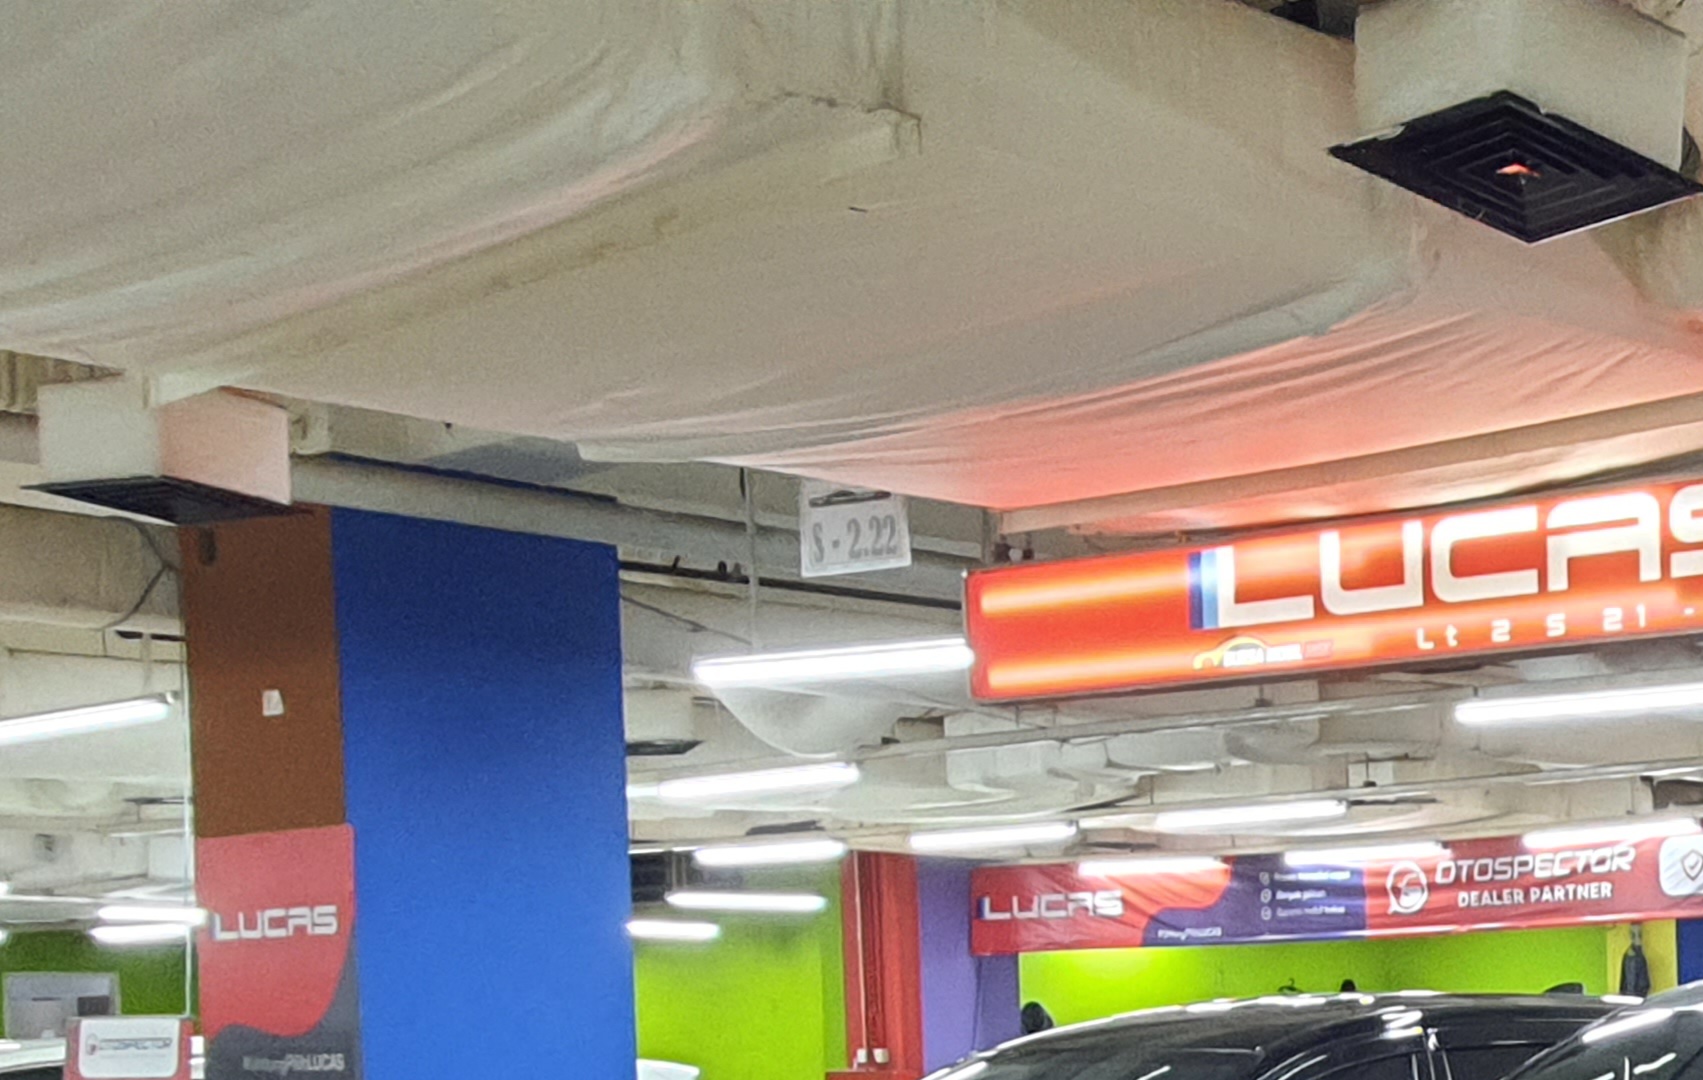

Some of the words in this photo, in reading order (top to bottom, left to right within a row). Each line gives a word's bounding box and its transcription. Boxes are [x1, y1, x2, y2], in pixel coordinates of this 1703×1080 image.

[1416, 623, 1459, 650] Lt
[1491, 619, 1511, 643] 2
[1602, 606, 1647, 633] 21
[1434, 846, 1636, 885] OTOSPECTOR
[984, 889, 1124, 921] LUCAS
[1458, 888, 1525, 908] DEALER
[1530, 882, 1613, 903] PARTNER
[213, 905, 338, 942] LUCAS
